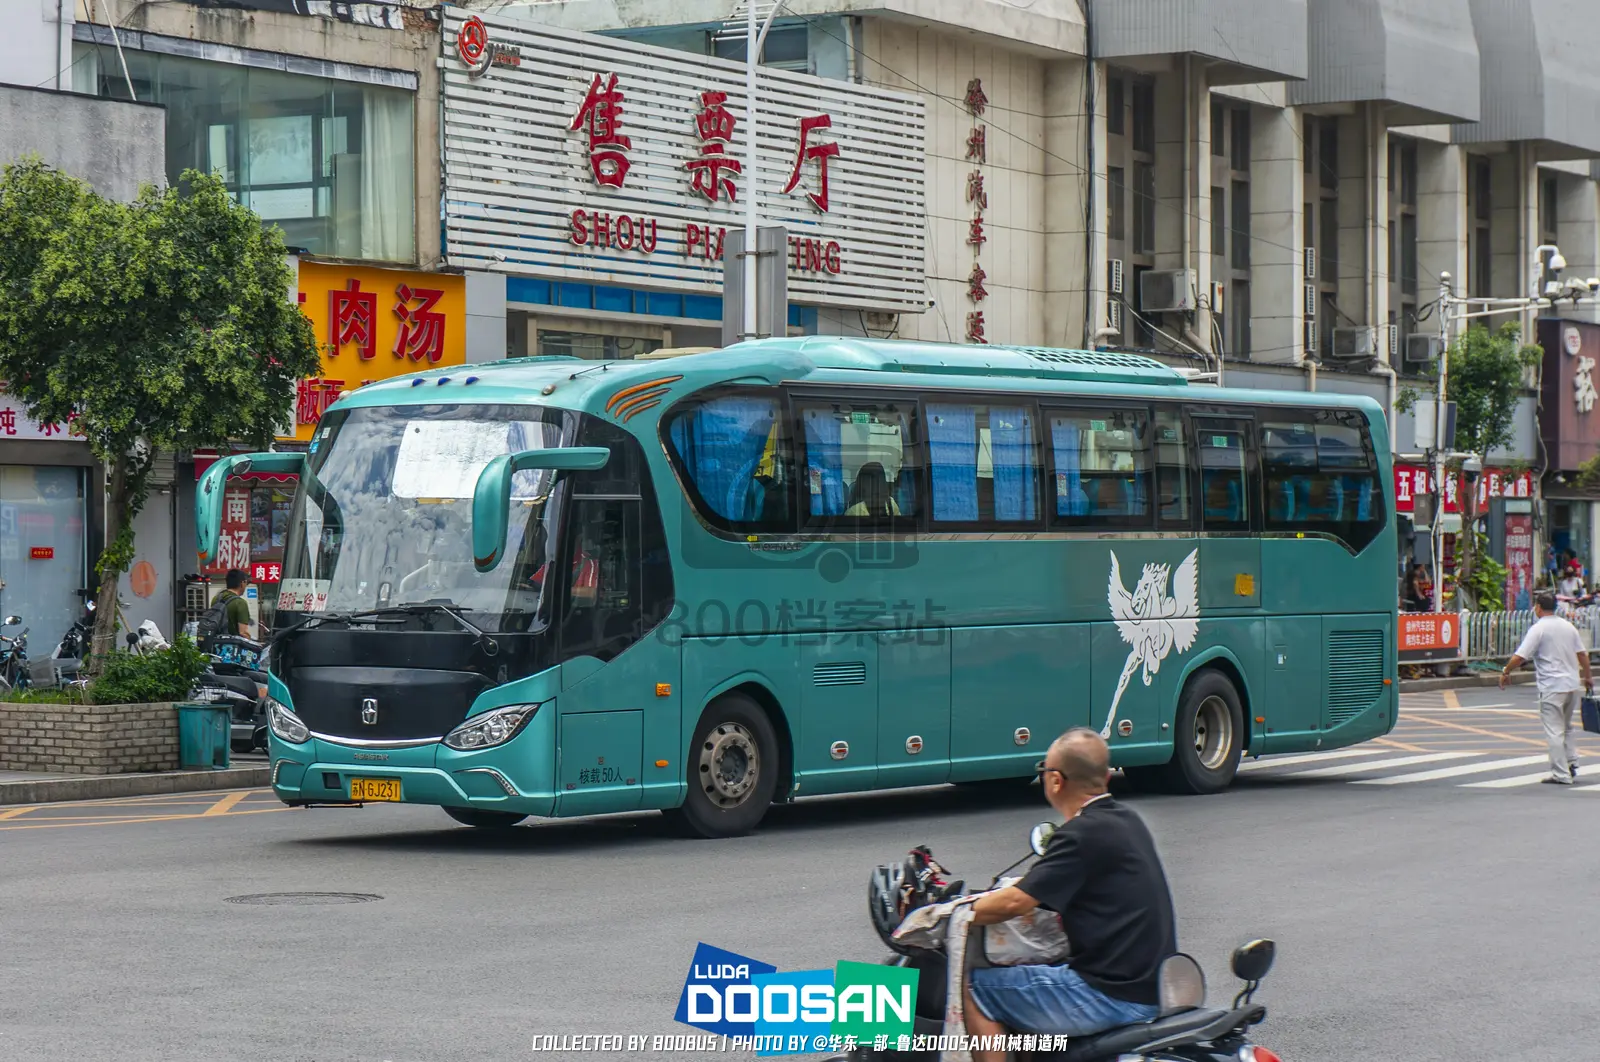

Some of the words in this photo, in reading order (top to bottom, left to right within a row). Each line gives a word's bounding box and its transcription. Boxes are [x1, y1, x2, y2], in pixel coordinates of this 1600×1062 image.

[566, 72, 840, 213] 售票厅
[569, 208, 656, 254] SHOU
[686, 223, 725, 260] PIA
[788, 236, 841, 275] ING
[298, 278, 446, 363] 肉汤
[225, 489, 248, 524] 南
[206, 529, 250, 570] 肉汤
